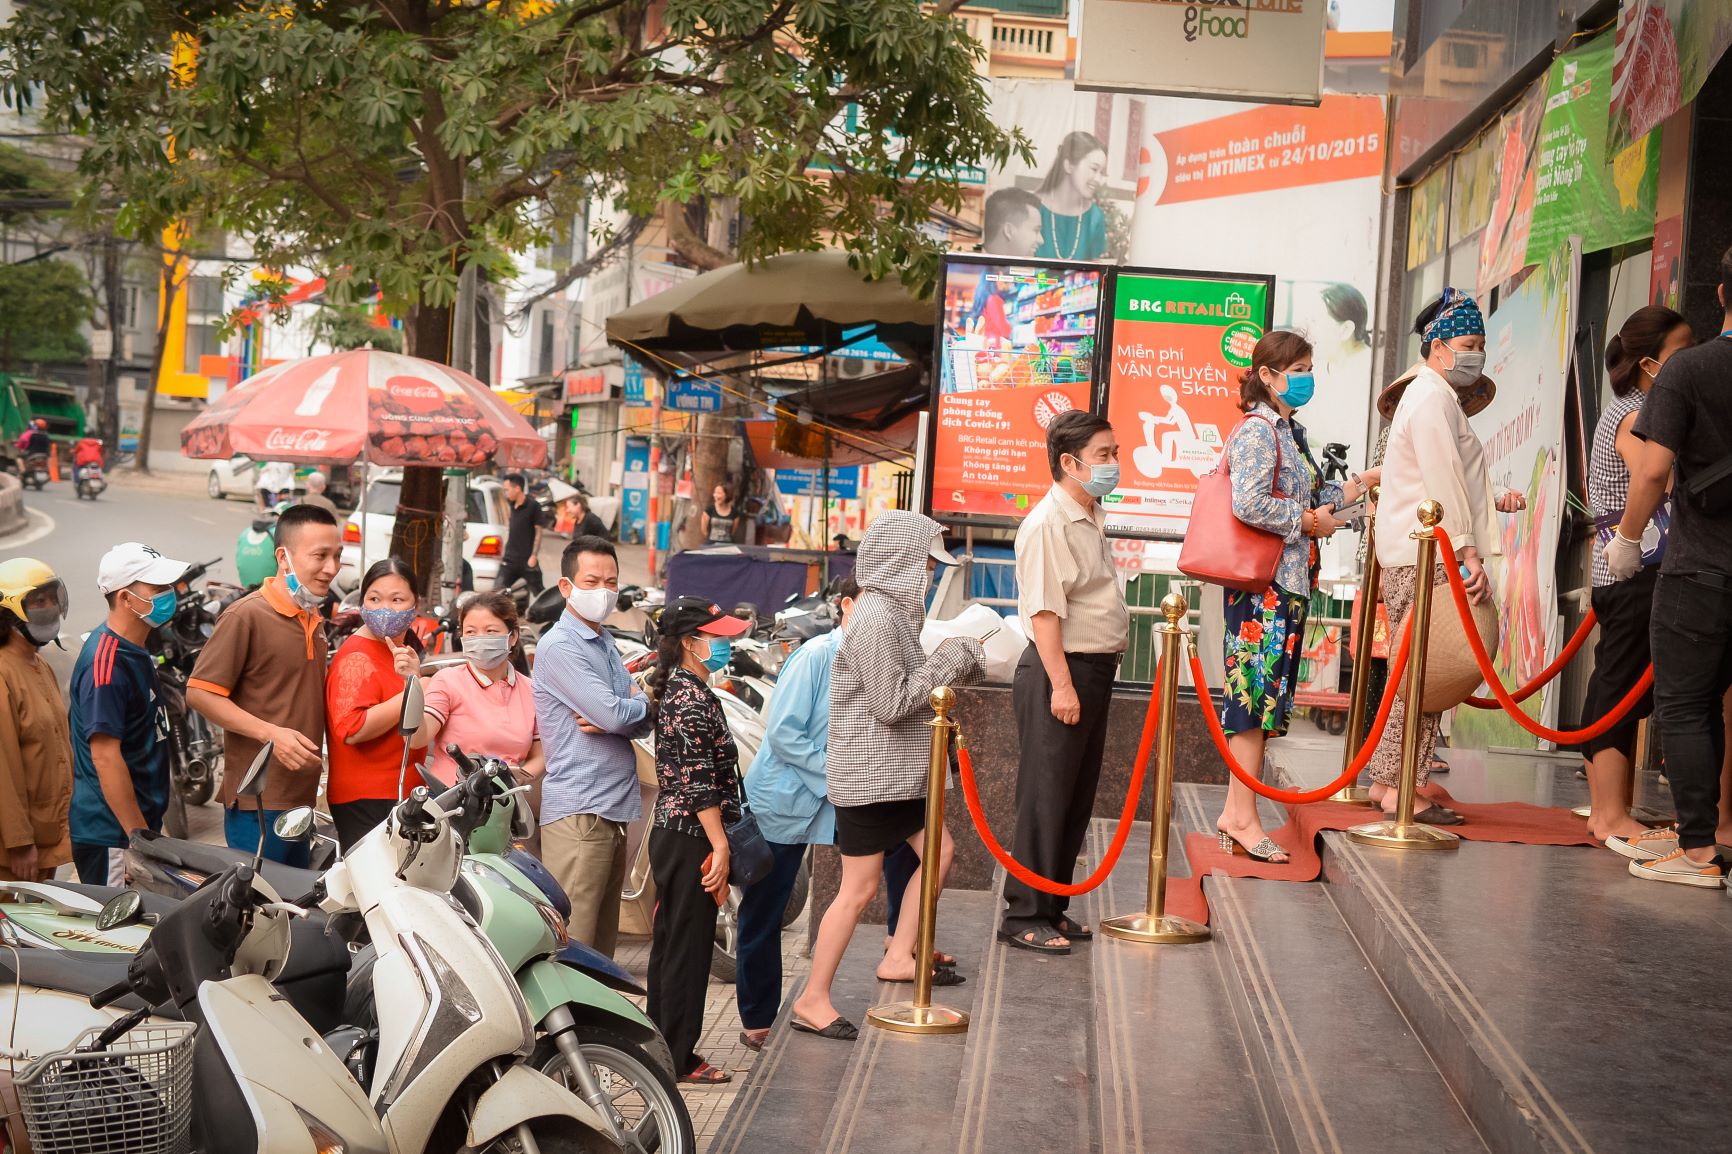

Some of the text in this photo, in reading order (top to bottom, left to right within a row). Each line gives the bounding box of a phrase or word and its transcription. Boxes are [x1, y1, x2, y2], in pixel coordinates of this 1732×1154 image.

[1199, 8, 1248, 38] Food
[1228, 138, 1259, 156] toàn
[1264, 124, 1305, 150] chuỗi
[1207, 154, 1265, 178] INTIMEX
[1282, 134, 1378, 167] 24/10/2015
[1129, 298, 1225, 317] BRG RETAIL
[1117, 344, 1184, 362] Miễn phí
[1117, 360, 1227, 382] VẬN CHUYỂN
[943, 395, 991, 407] Chung tay
[943, 407, 1003, 419] phòng chống
[942, 418, 1011, 430] dịch Covid-19!
[958, 434, 974, 443] BRG
[976, 435, 997, 445] Retail
[998, 438, 1014, 447] cam
[964, 446, 1027, 458] Không giới hạn
[963, 461, 990, 470] Không
[992, 462, 1011, 473] tăng
[963, 471, 999, 481] An toàn
[1144, 496, 1167, 504] Intimex
